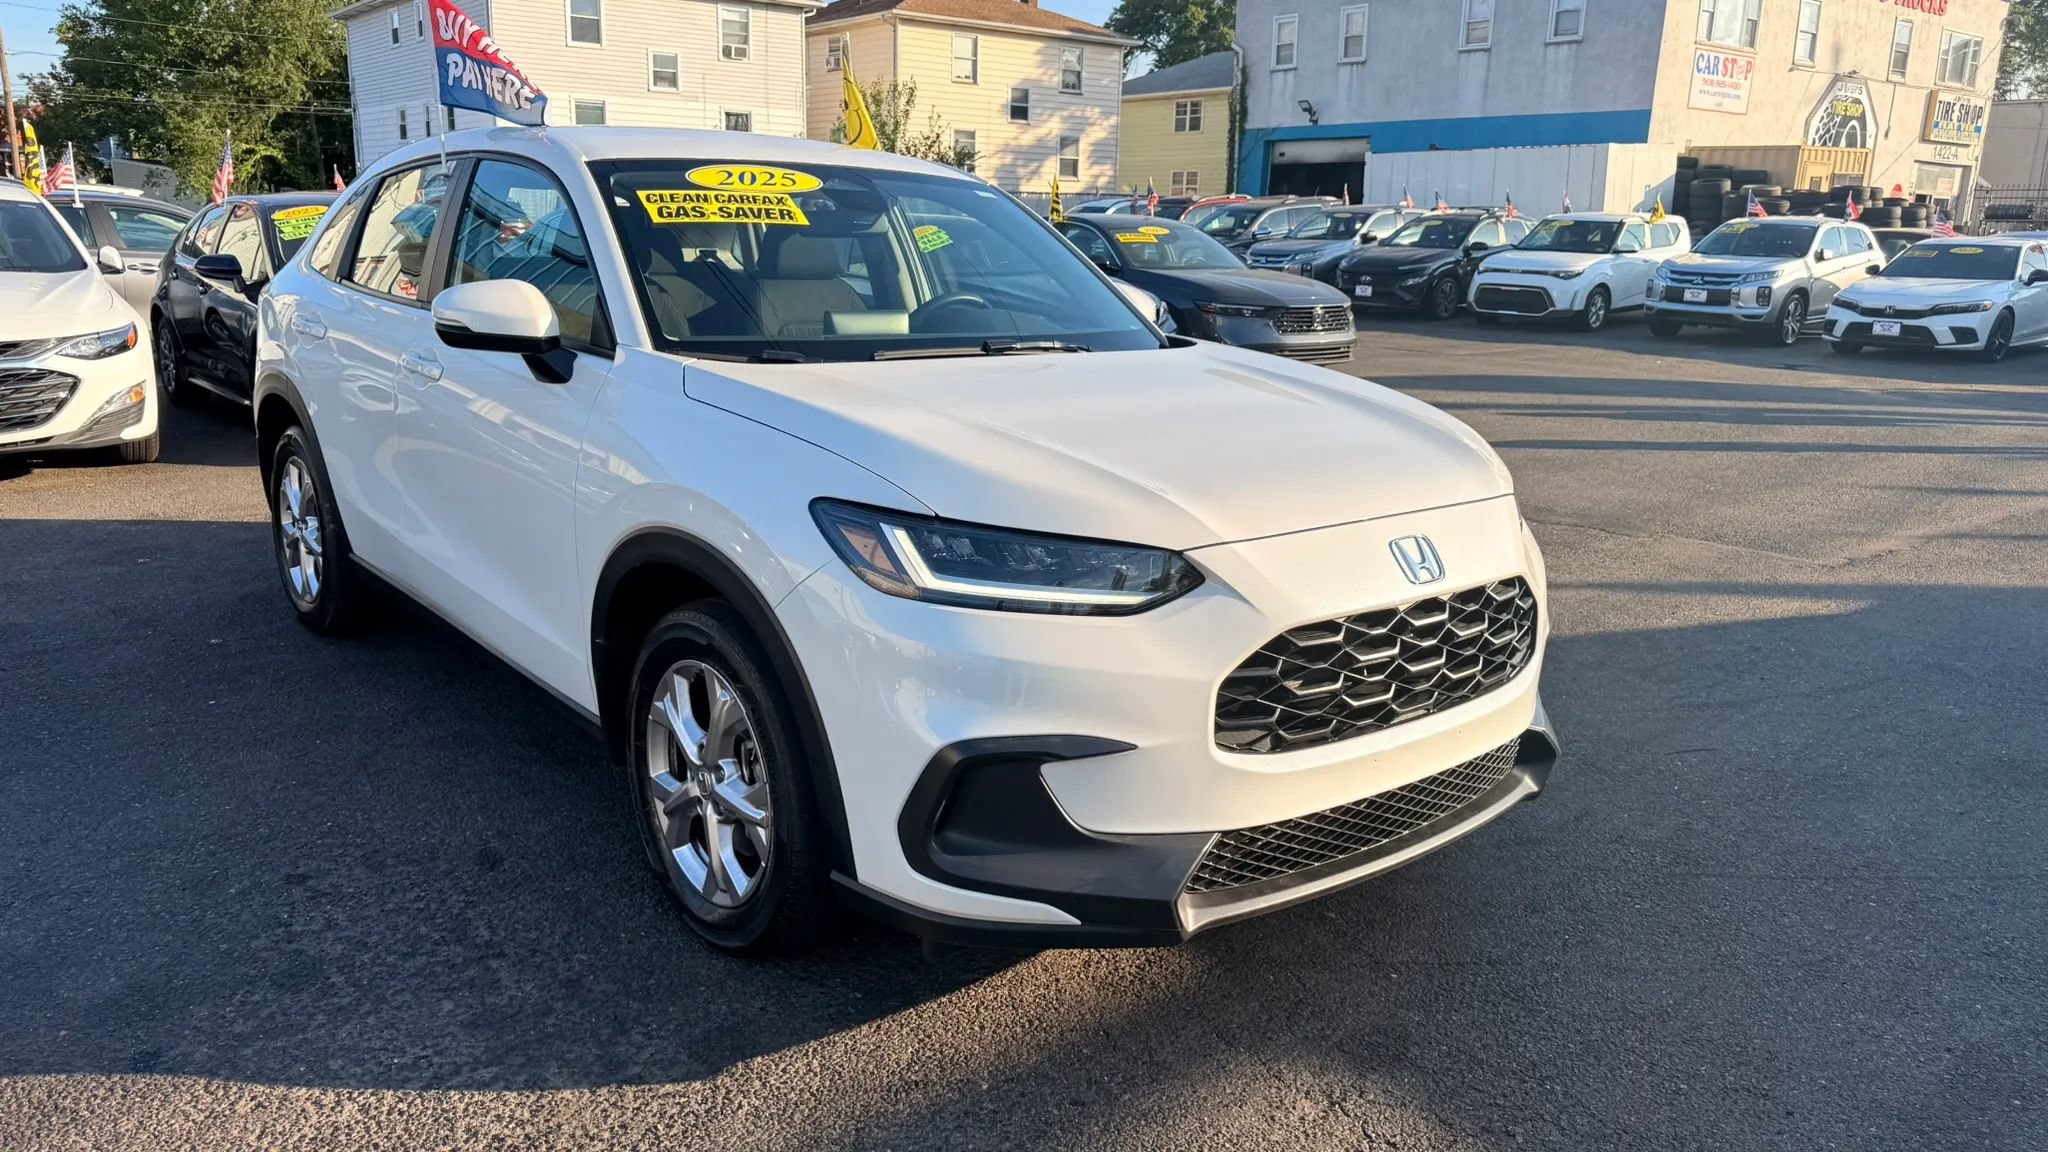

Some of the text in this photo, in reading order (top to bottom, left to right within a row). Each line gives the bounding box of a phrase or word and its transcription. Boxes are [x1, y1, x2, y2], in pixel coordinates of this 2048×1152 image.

[1696, 53, 1720, 76] CAR
[1936, 100, 1984, 125] TIRE SHOP
[715, 169, 798, 187] 2025
[645, 192, 790, 207] CLEAN CARFAX
[656, 205, 798, 222] GAS-SAVER
